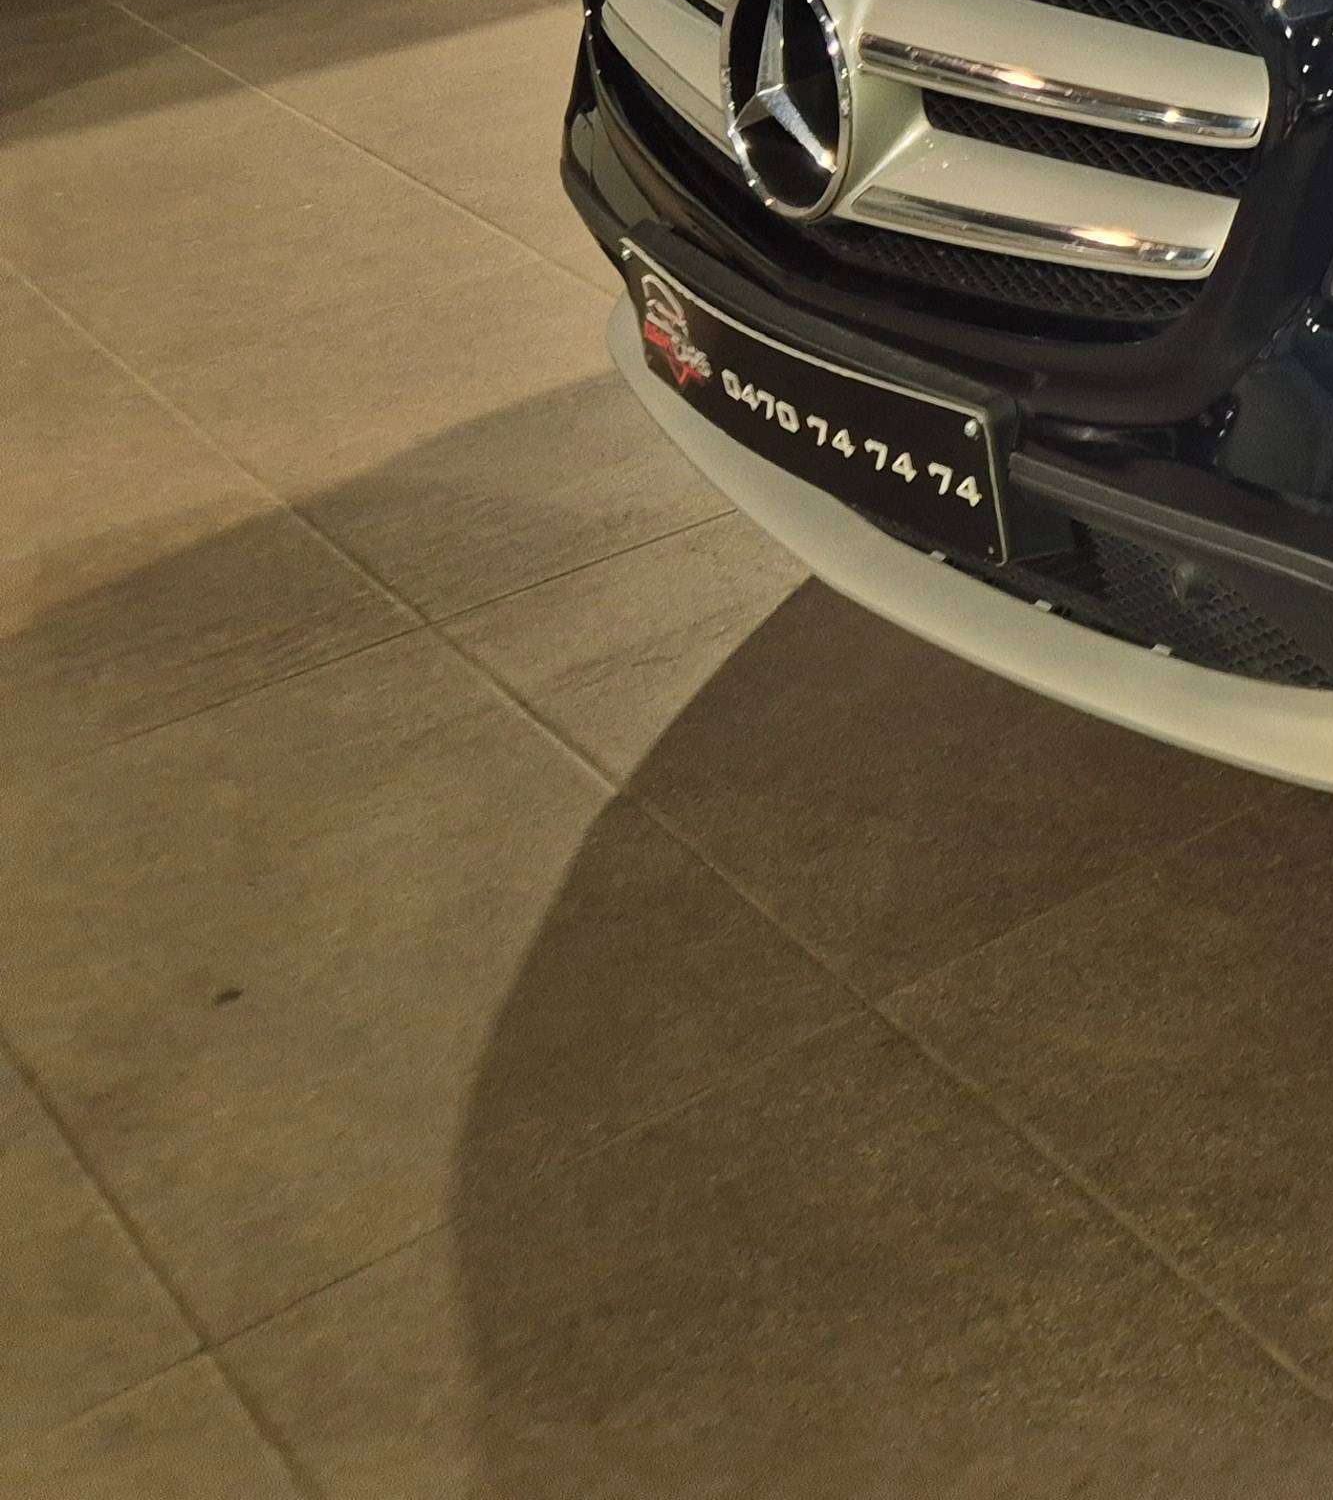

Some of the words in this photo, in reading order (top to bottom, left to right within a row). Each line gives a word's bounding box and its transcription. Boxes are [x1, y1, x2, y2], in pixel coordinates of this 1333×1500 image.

[721, 368, 800, 434] 0470
[806, 414, 856, 459] 74
[863, 438, 918, 484] 74
[927, 462, 983, 508] 74
